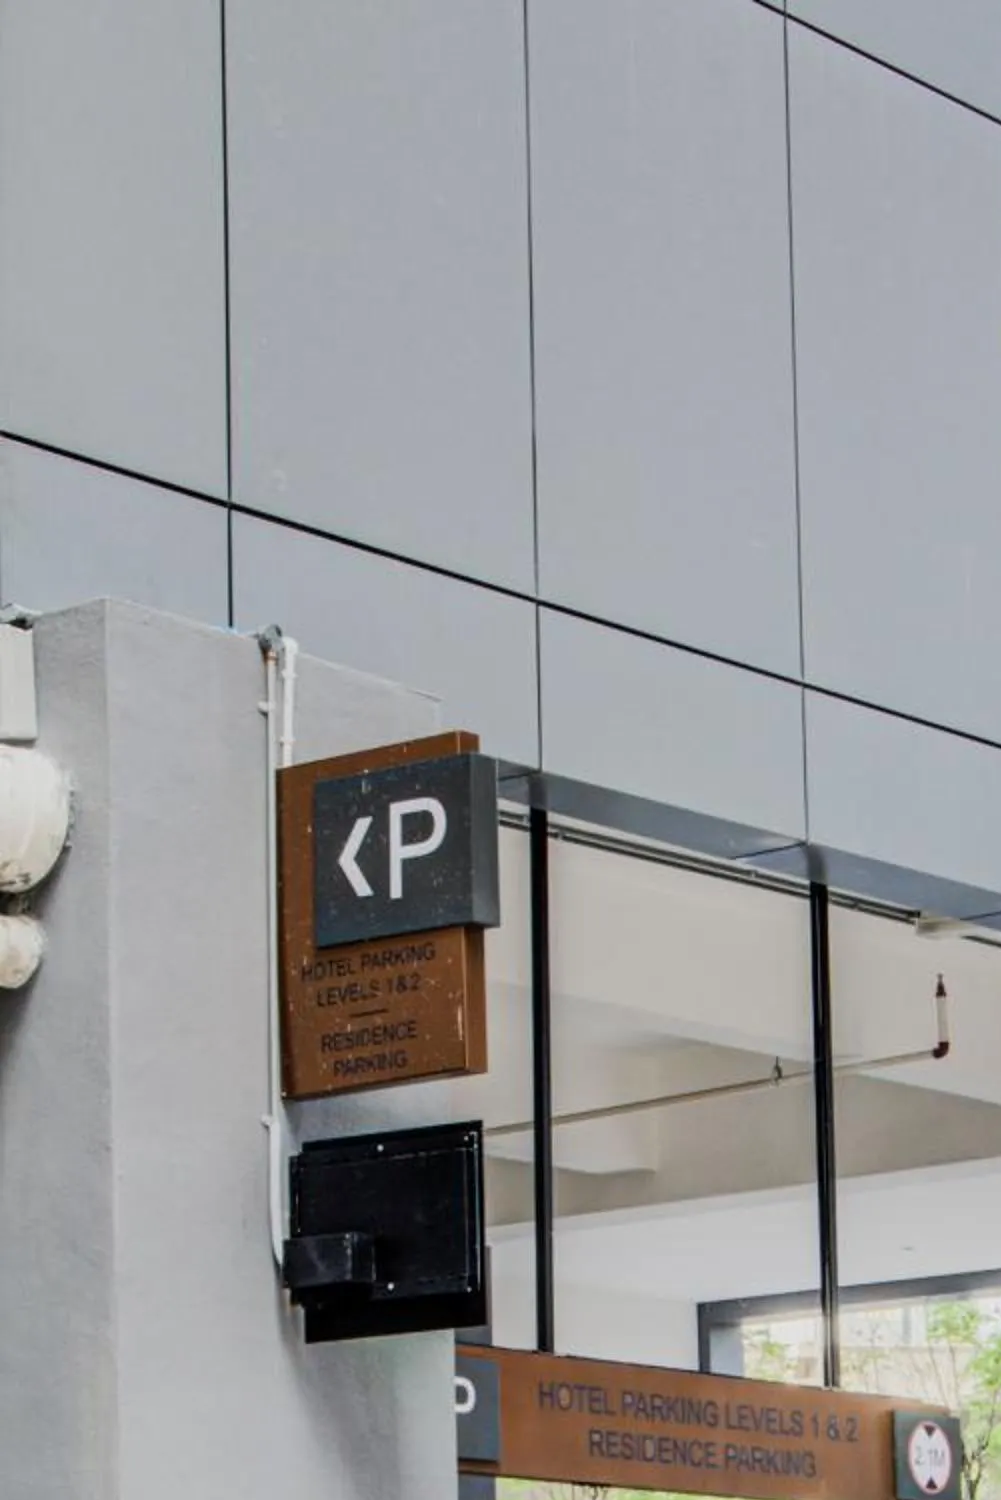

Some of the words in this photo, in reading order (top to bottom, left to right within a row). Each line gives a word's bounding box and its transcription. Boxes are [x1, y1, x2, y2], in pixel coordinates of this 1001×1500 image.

[388, 797, 448, 899] P
[301, 960, 356, 982] HOTEL
[360, 942, 436, 972] PARKING
[316, 980, 381, 1008] LEVELS
[320, 1020, 418, 1054] RESIDENCE
[332, 1049, 408, 1078] PARKING
[538, 1381, 615, 1416] HOTEL
[621, 1390, 719, 1429] PARKING
[724, 1400, 804, 1438] LEVELS
[845, 1414, 860, 1443] 2
[588, 1428, 719, 1470] RESIDENCE
[724, 1443, 817, 1479] PARKING
